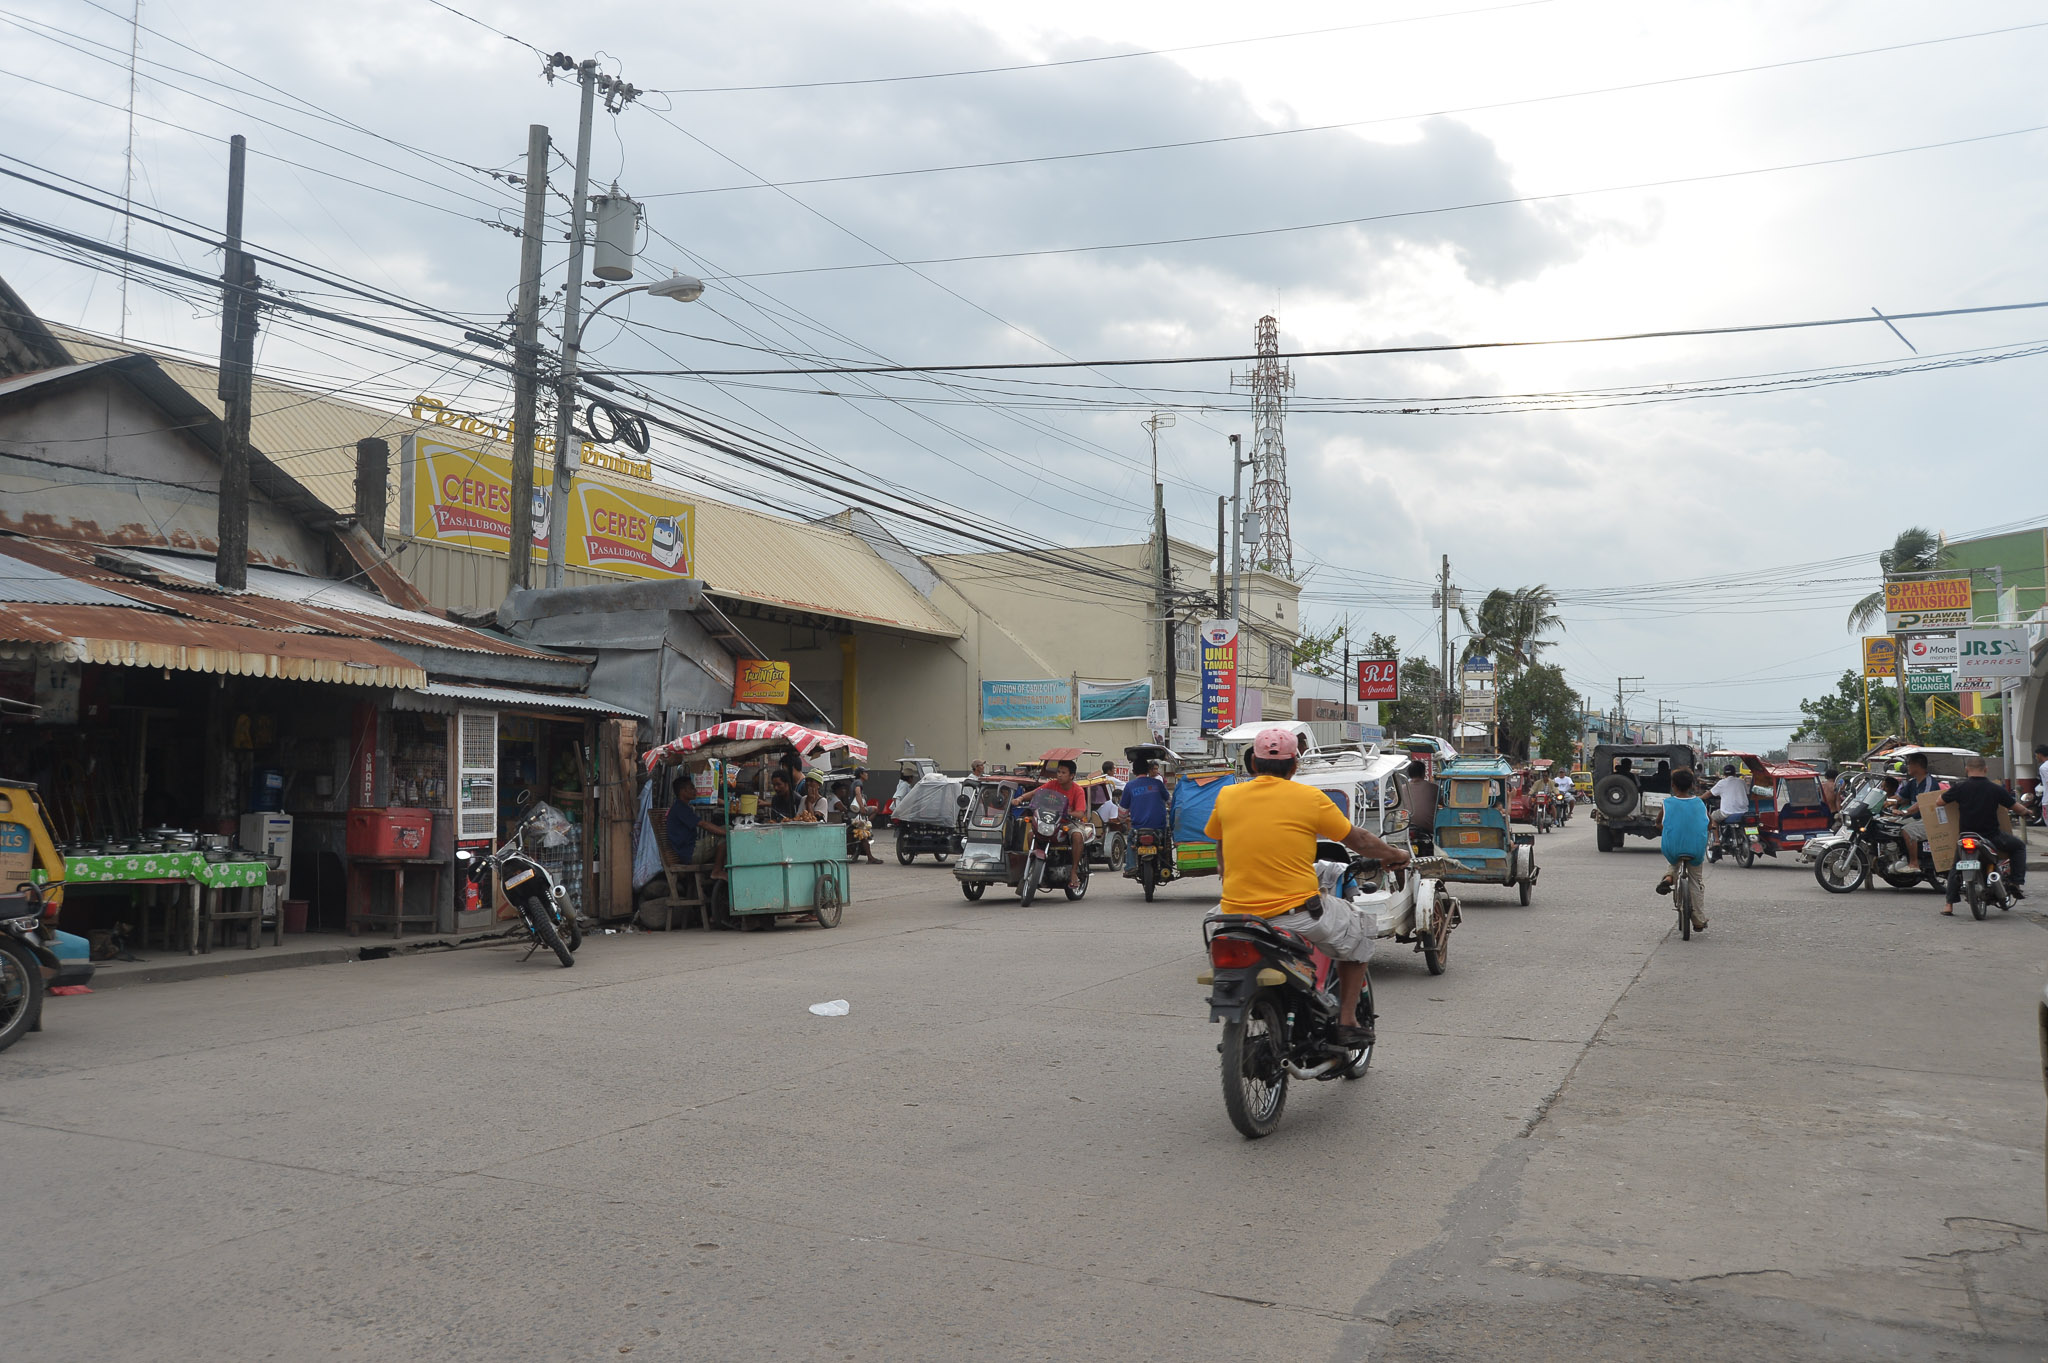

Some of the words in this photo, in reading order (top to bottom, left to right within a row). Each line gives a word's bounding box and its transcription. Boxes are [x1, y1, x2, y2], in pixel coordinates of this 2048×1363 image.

[443, 474, 511, 514] CERES
[439, 511, 511, 535] PASALUBONG
[593, 508, 647, 543] CERES
[590, 541, 648, 561] PASALUBONG
[1902, 581, 1968, 597] PALAWAN
[1889, 594, 1968, 610] PAWNSHOP
[1205, 648, 1233, 660] UNLI
[1960, 641, 2002, 656] JRS
[1204, 661, 1235, 670] TAWAG
[1363, 664, 1395, 683] RL
[1911, 675, 1950, 683] MONEY
[1911, 683, 1950, 691] CHANGER
[1017, 684, 1025, 694] OF
[1055, 695, 1067, 705] DAY
[364, 753, 373, 803] SMART
